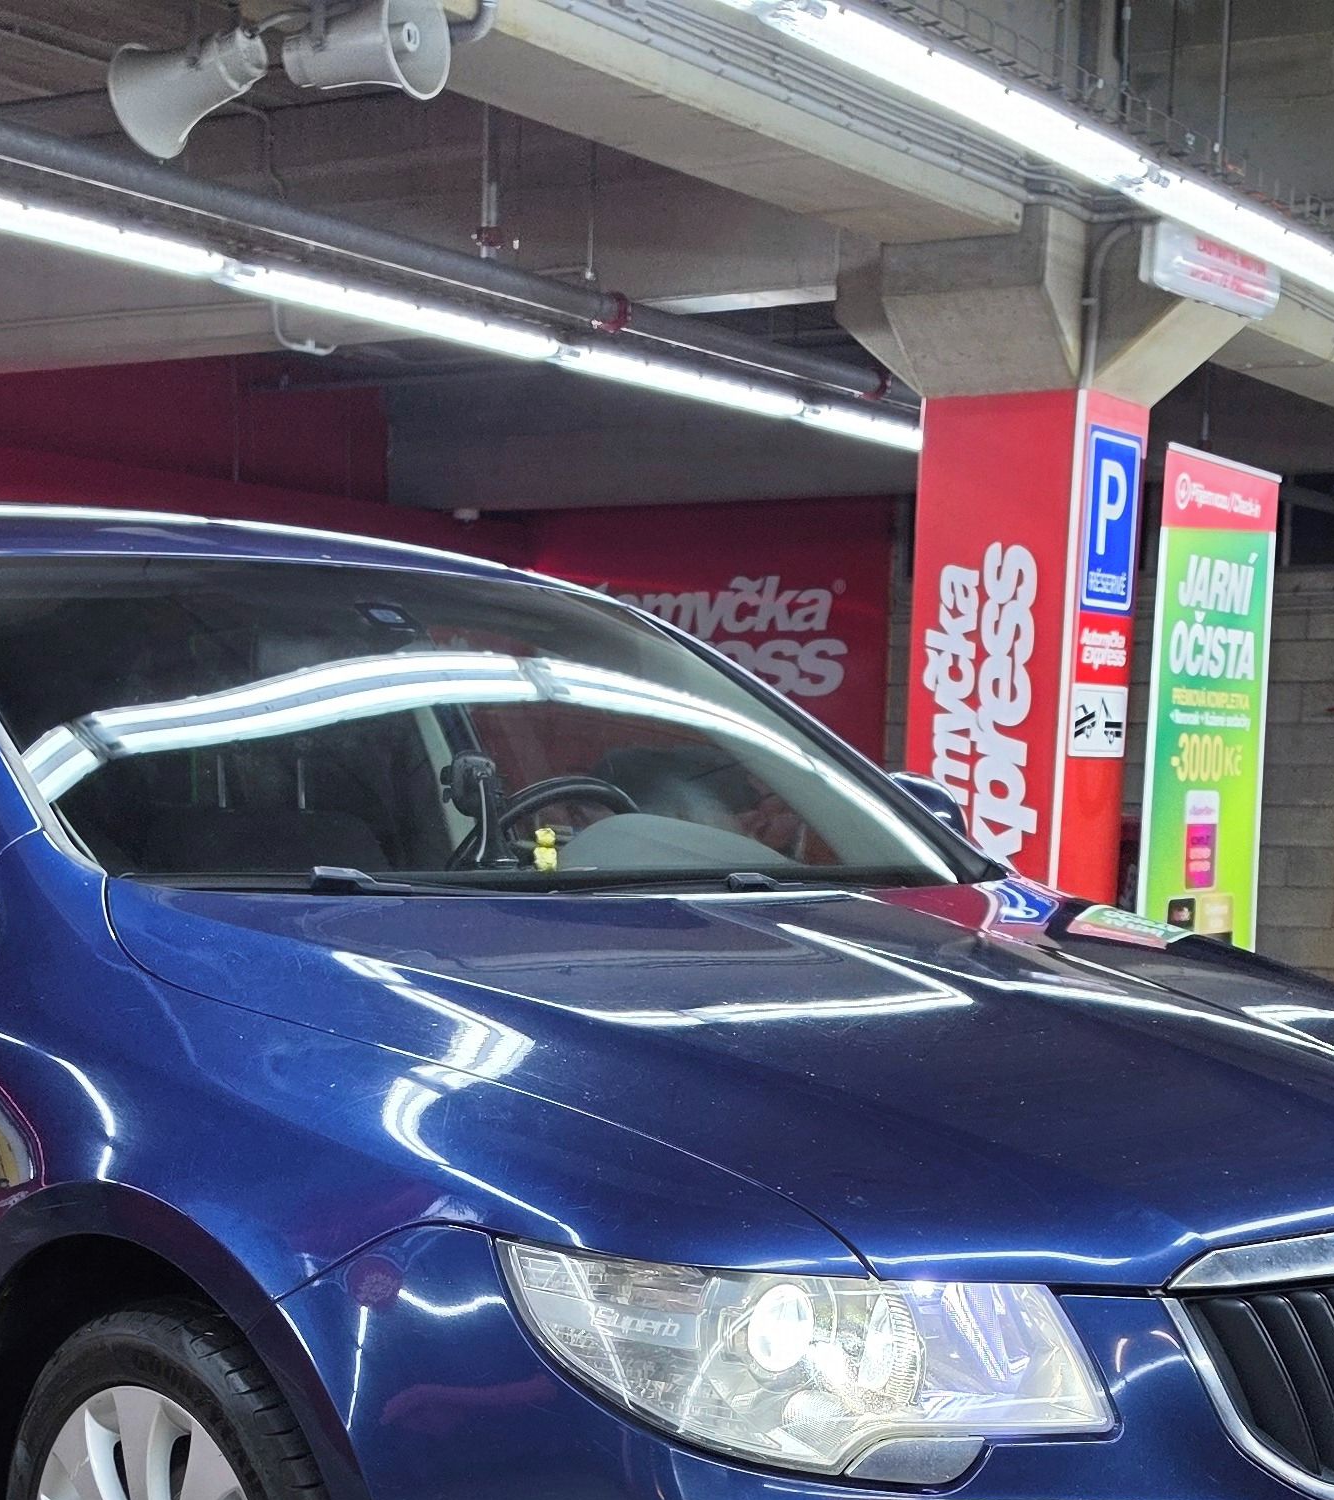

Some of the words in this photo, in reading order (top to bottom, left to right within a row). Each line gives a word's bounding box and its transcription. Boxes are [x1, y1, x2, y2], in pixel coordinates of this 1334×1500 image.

[1095, 458, 1128, 556] P
[1178, 552, 1259, 616] JARNÍ
[1169, 610, 1255, 681] OČISTA
[971, 541, 1038, 880] xpress
[1170, 732, 1224, 783] -3000
[1224, 743, 1244, 777] Kč
[593, 1305, 681, 1338] Superb
